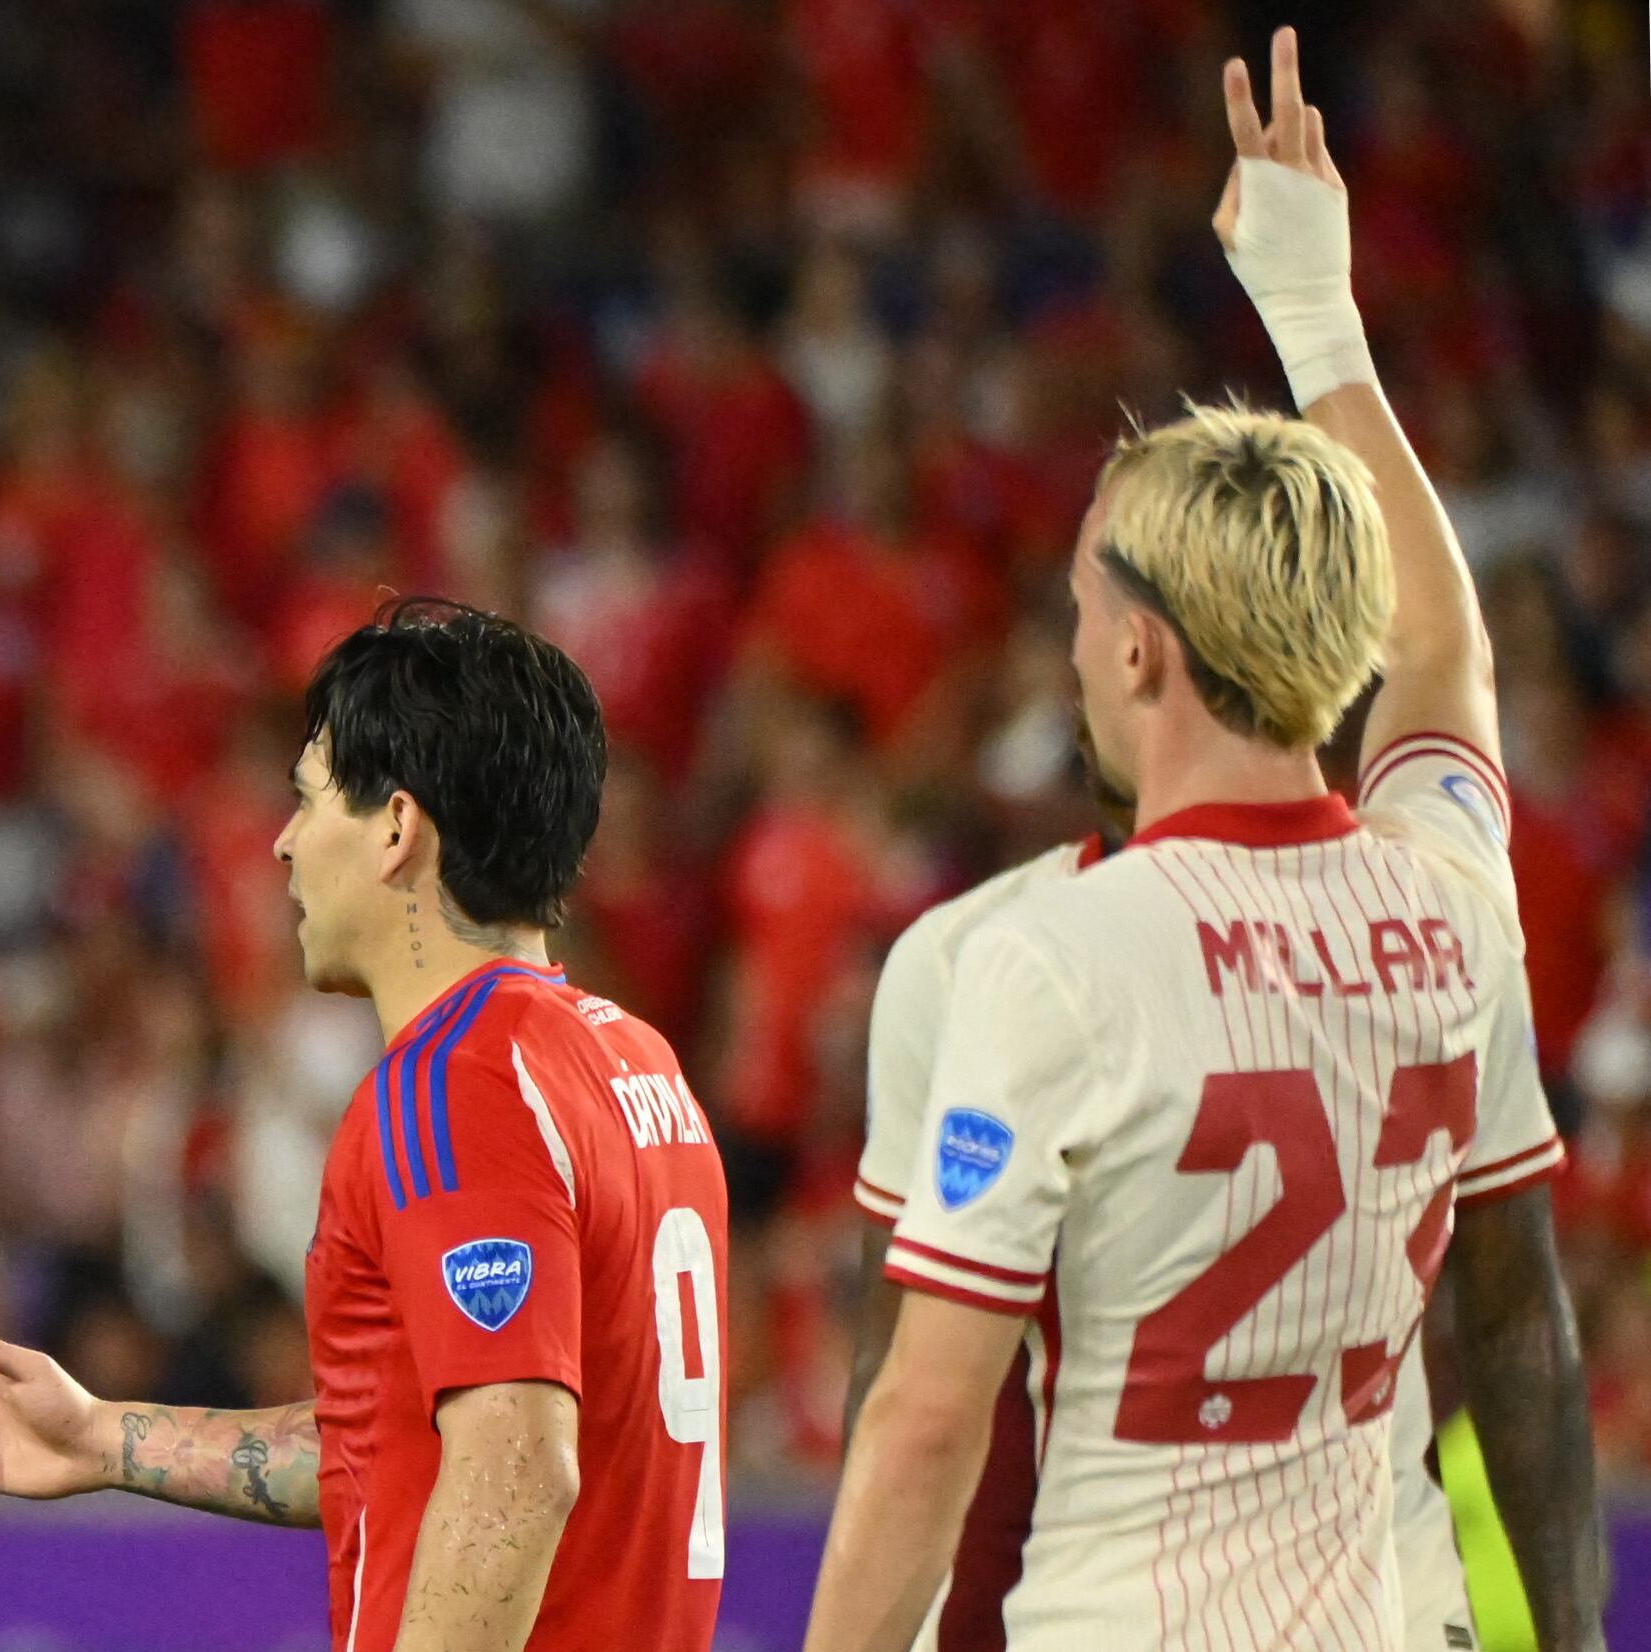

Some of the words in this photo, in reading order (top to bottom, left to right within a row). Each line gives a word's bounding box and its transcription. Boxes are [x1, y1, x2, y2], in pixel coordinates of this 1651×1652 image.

[1197, 917, 1475, 997] MILLAR
[609, 1058, 709, 1149] DÁVILA
[455, 1260, 522, 1283] VIBRA
[1114, 1050, 1478, 1443] 23
[651, 1206, 725, 1580] 9
